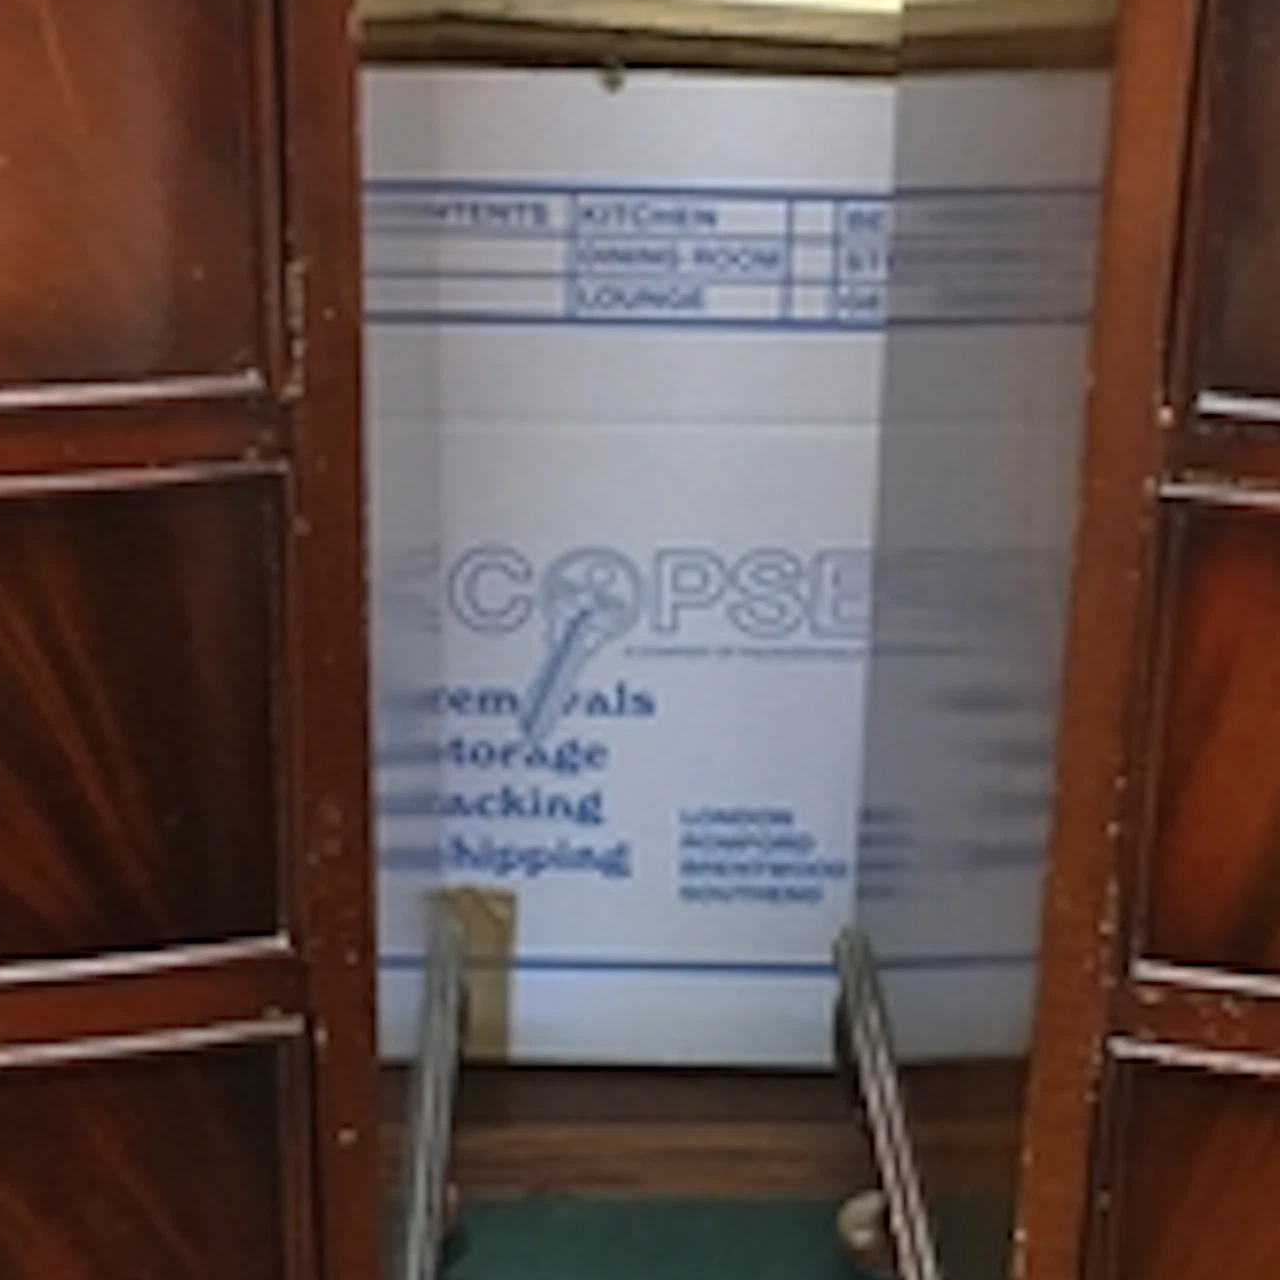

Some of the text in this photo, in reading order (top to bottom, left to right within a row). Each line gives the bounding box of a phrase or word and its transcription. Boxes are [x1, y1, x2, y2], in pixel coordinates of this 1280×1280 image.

[580, 203, 718, 228] KITCHEN
[693, 247, 783, 273] ROOM
[576, 284, 705, 312] LOUNGE
